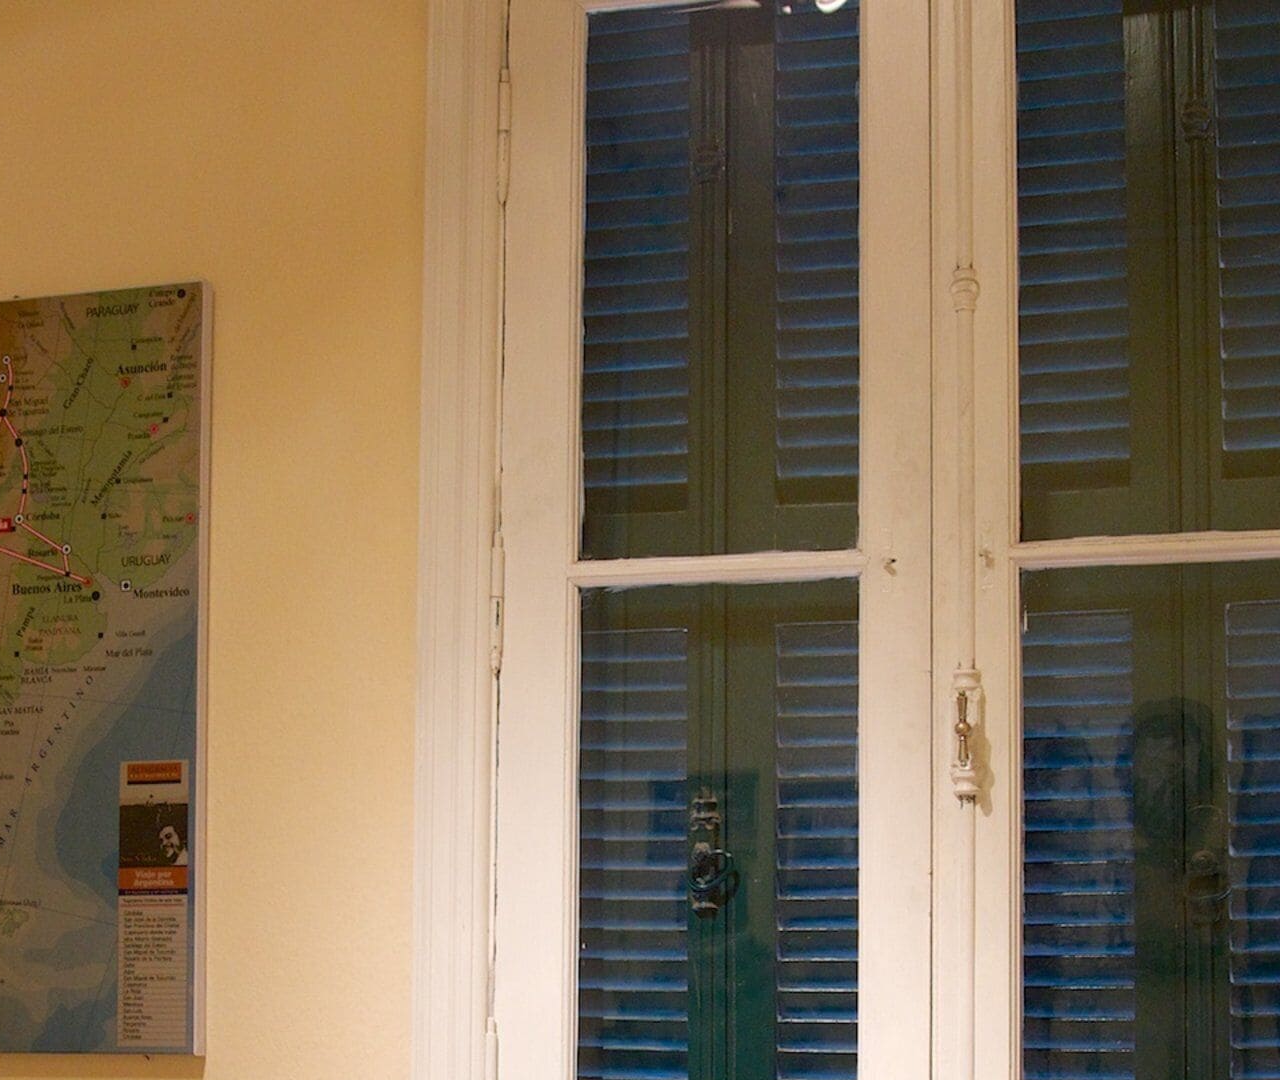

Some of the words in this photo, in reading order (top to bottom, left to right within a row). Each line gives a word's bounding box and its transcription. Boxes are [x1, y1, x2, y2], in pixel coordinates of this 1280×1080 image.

[86, 303, 140, 318] PARAGUAY
[117, 360, 168, 375] Asunción
[63, 386, 81, 409] Gran
[77, 357, 94, 386] Chaco
[90, 450, 132, 505] Mesopotamia
[121, 553, 172, 568] URUGUAY
[12, 583, 51, 596] Buenos
[54, 580, 83, 593] Aires
[133, 588, 190, 600] Montevideo
[16, 606, 36, 638] Pampa
